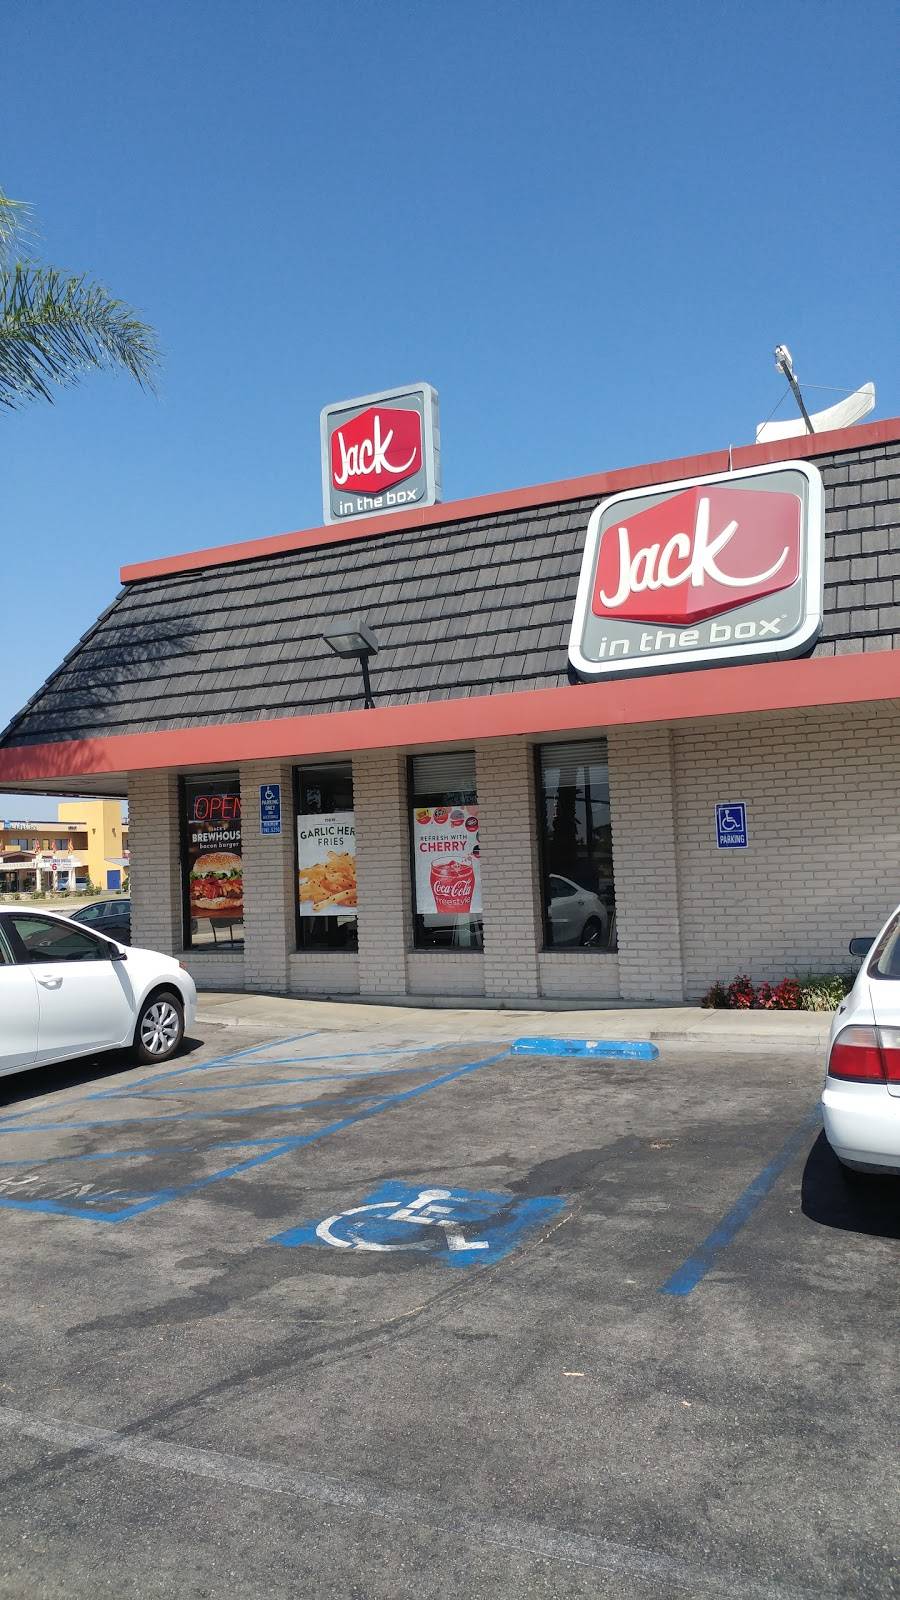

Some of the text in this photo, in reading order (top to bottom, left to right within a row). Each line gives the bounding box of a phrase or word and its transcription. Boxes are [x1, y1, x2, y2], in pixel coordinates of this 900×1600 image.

[334, 415, 417, 485] Jack
[339, 488, 417, 515] in the box
[599, 498, 790, 609] Jack
[598, 617, 781, 658] in the box
[300, 826, 335, 840] GARLIC
[720, 834, 745, 844] PARKING
[218, 841, 240, 850] burger
[318, 837, 344, 846] FRIES
[419, 841, 467, 853] CHERRY
